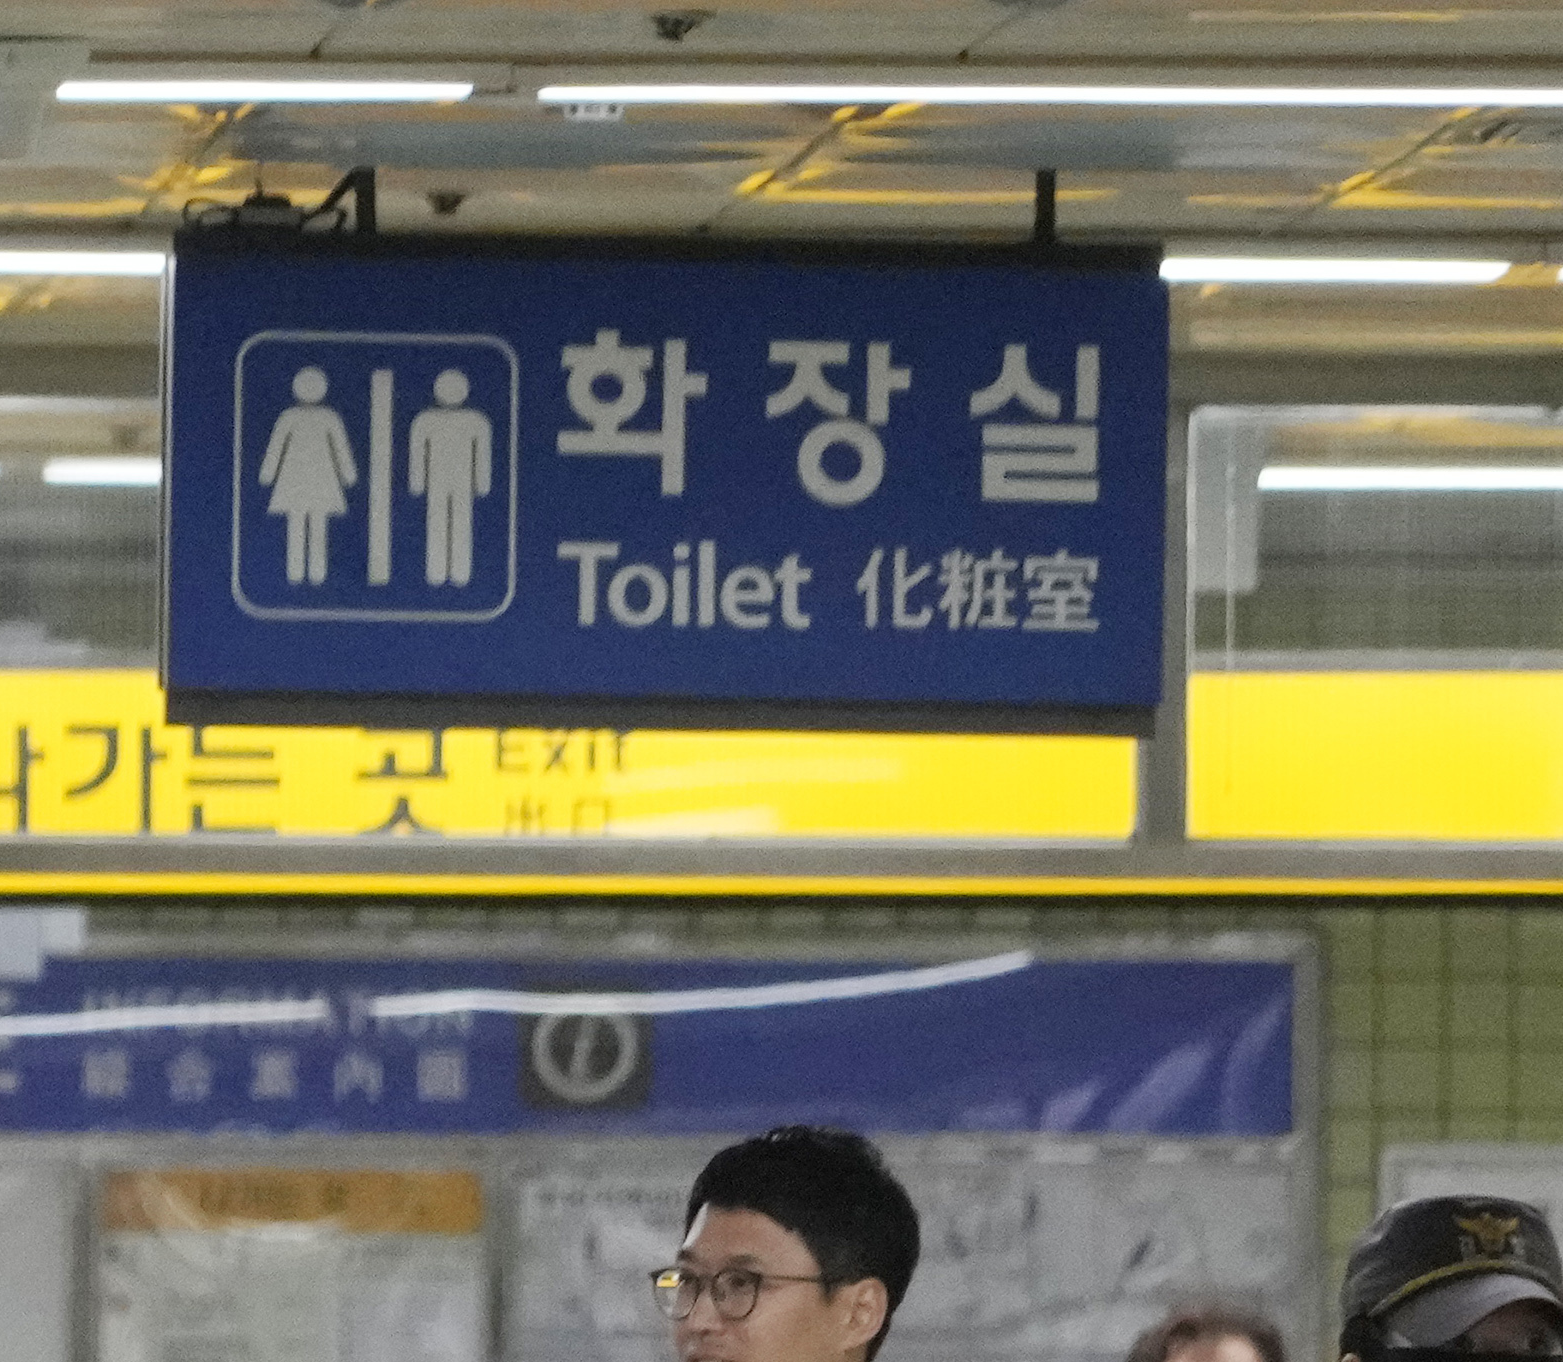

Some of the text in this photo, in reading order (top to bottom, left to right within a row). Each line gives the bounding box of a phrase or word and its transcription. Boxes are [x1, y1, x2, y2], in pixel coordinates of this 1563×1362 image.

[556, 328, 1101, 507] 화장실
[556, 541, 1100, 634] Toilet 化粧室
